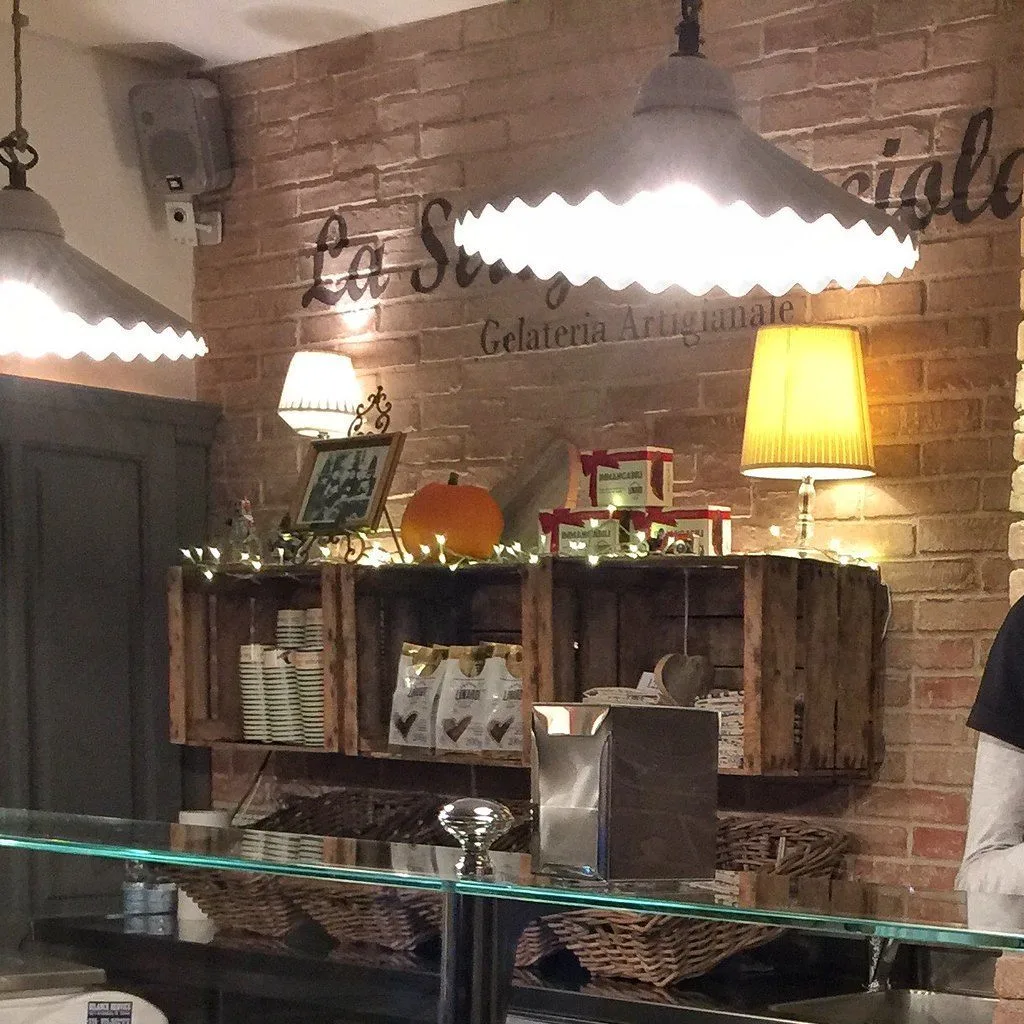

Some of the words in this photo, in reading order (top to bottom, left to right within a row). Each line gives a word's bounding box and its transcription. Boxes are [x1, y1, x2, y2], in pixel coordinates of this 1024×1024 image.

[302, 213, 390, 308] La
[480, 312, 607, 355] Gelateria
[620, 297, 795, 347] Artigianale
